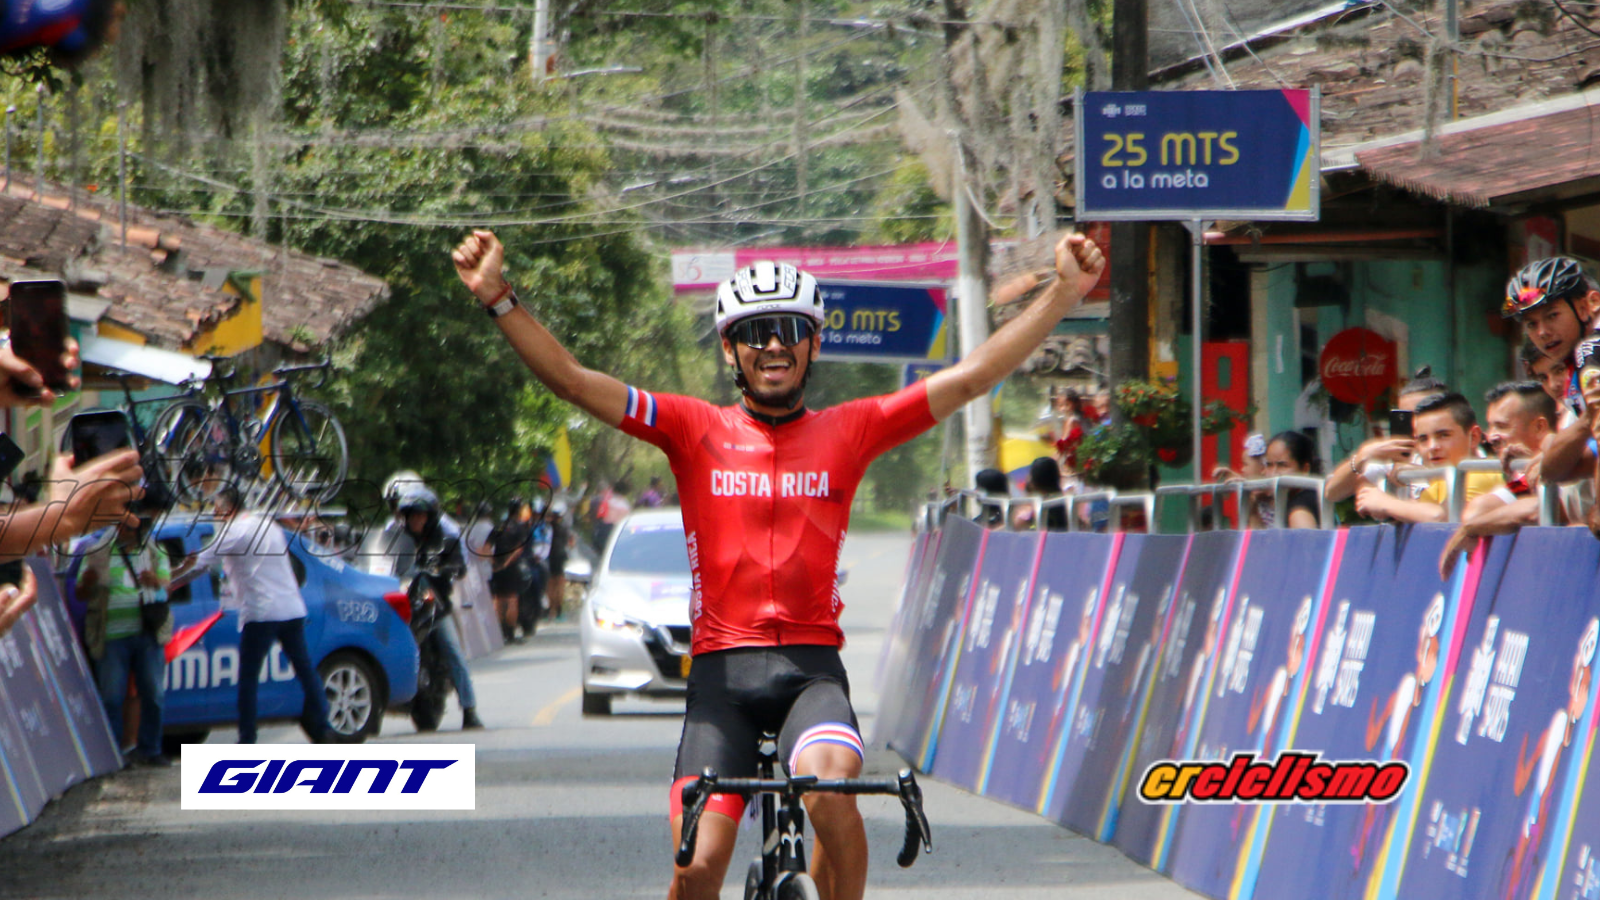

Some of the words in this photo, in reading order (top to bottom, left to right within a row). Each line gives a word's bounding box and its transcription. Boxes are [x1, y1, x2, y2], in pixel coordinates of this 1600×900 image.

[1102, 133, 1147, 166] 25
[1161, 132, 1240, 165] MTS
[1102, 174, 1117, 188] a
[1123, 170, 1145, 188] la
[1151, 169, 1209, 188] meta
[852, 310, 902, 332] MTS
[846, 333, 882, 345] meta
[711, 469, 772, 497] COSTA
[782, 471, 829, 497] RICA
[337, 600, 379, 623] PRO
